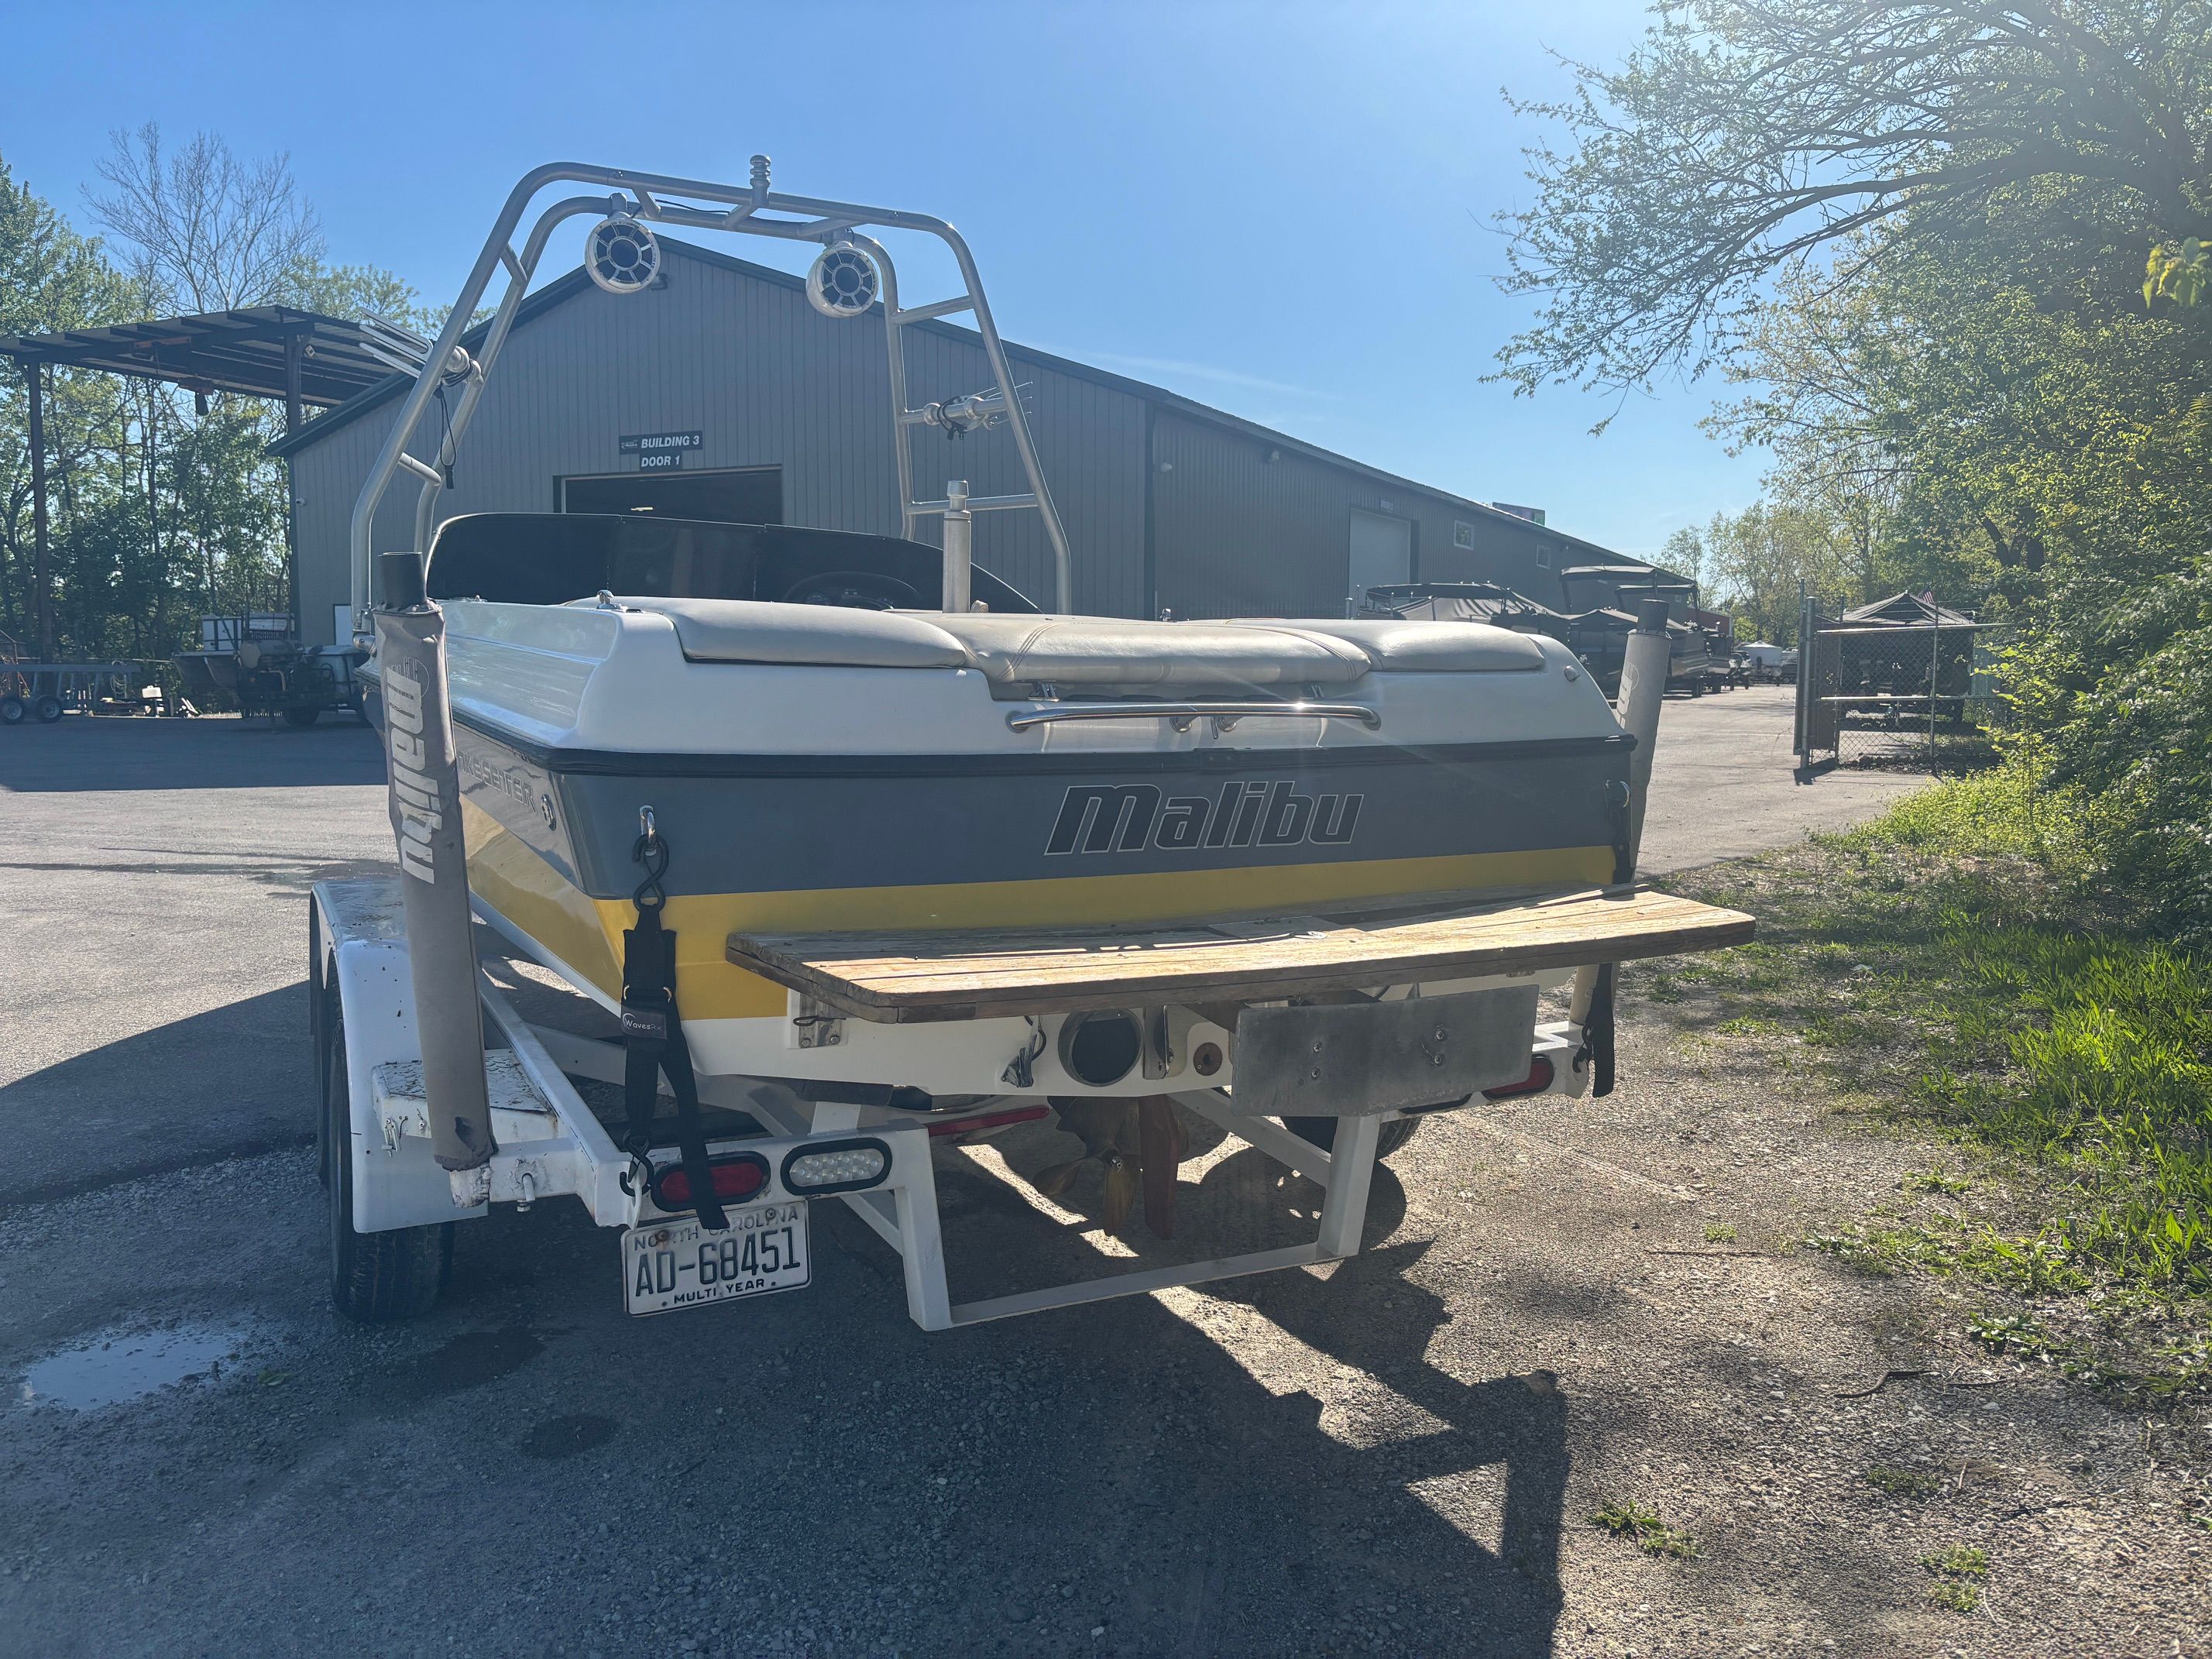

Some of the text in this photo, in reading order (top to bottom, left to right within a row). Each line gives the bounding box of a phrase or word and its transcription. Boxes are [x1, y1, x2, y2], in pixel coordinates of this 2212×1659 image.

[641, 437, 689, 448] BUILDING
[693, 435, 699, 445] 3
[641, 455, 680, 467] DOOR 1
[1043, 781, 1364, 856] Malibu
[635, 1227, 801, 1297] AD-68451
[673, 1278, 764, 1304] MULTI YEAR
